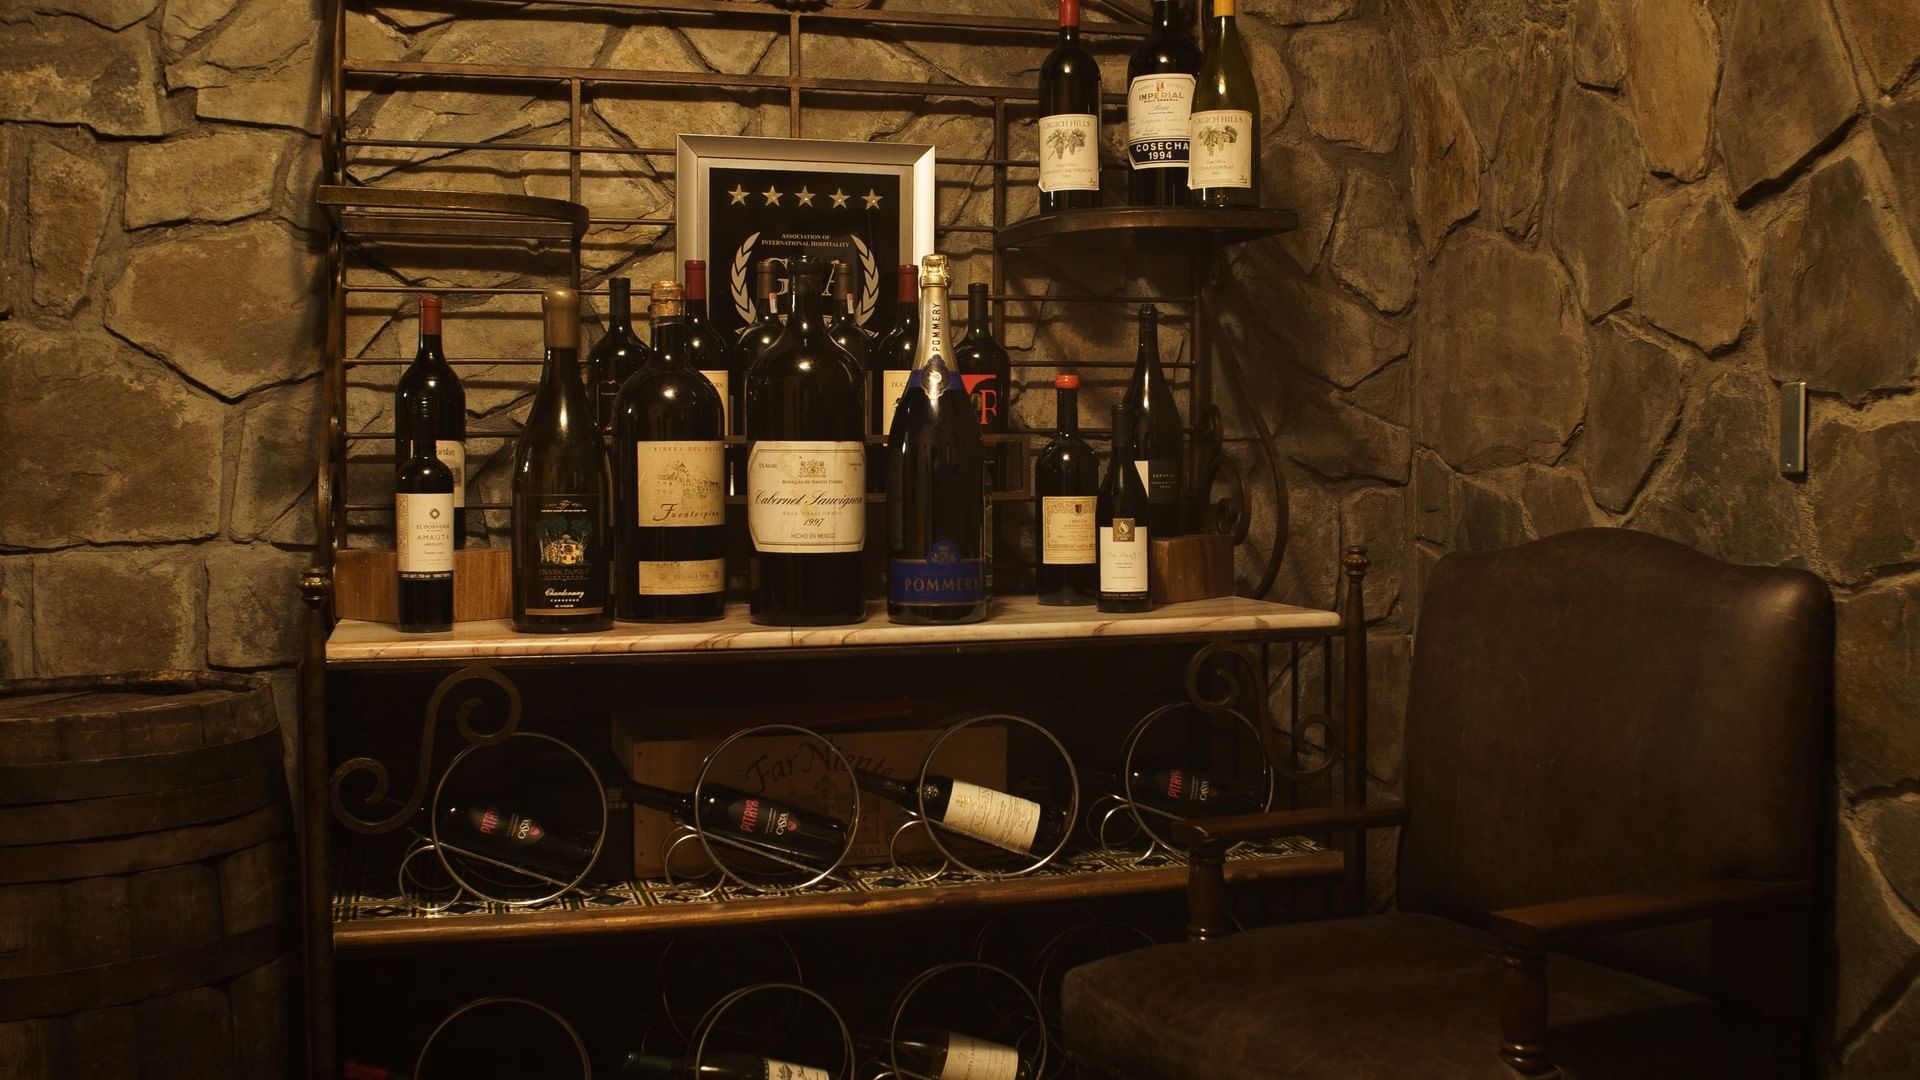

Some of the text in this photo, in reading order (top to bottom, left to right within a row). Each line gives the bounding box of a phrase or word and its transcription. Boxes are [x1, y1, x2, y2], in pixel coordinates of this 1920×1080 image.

[1139, 91, 1184, 101] IMPERIAL
[1220, 115, 1243, 123] HILLS
[1136, 142, 1189, 152] COSECHA
[1148, 151, 1172, 160] 1994
[761, 239, 810, 247] INTERNATIONAL
[932, 303, 941, 352] POMMERY
[755, 489, 806, 505] Cabernet
[803, 518, 824, 528] 1997
[905, 577, 978, 592] POMMERY
[544, 587, 585, 598] Chardonnay
[745, 752, 799, 793] Far
